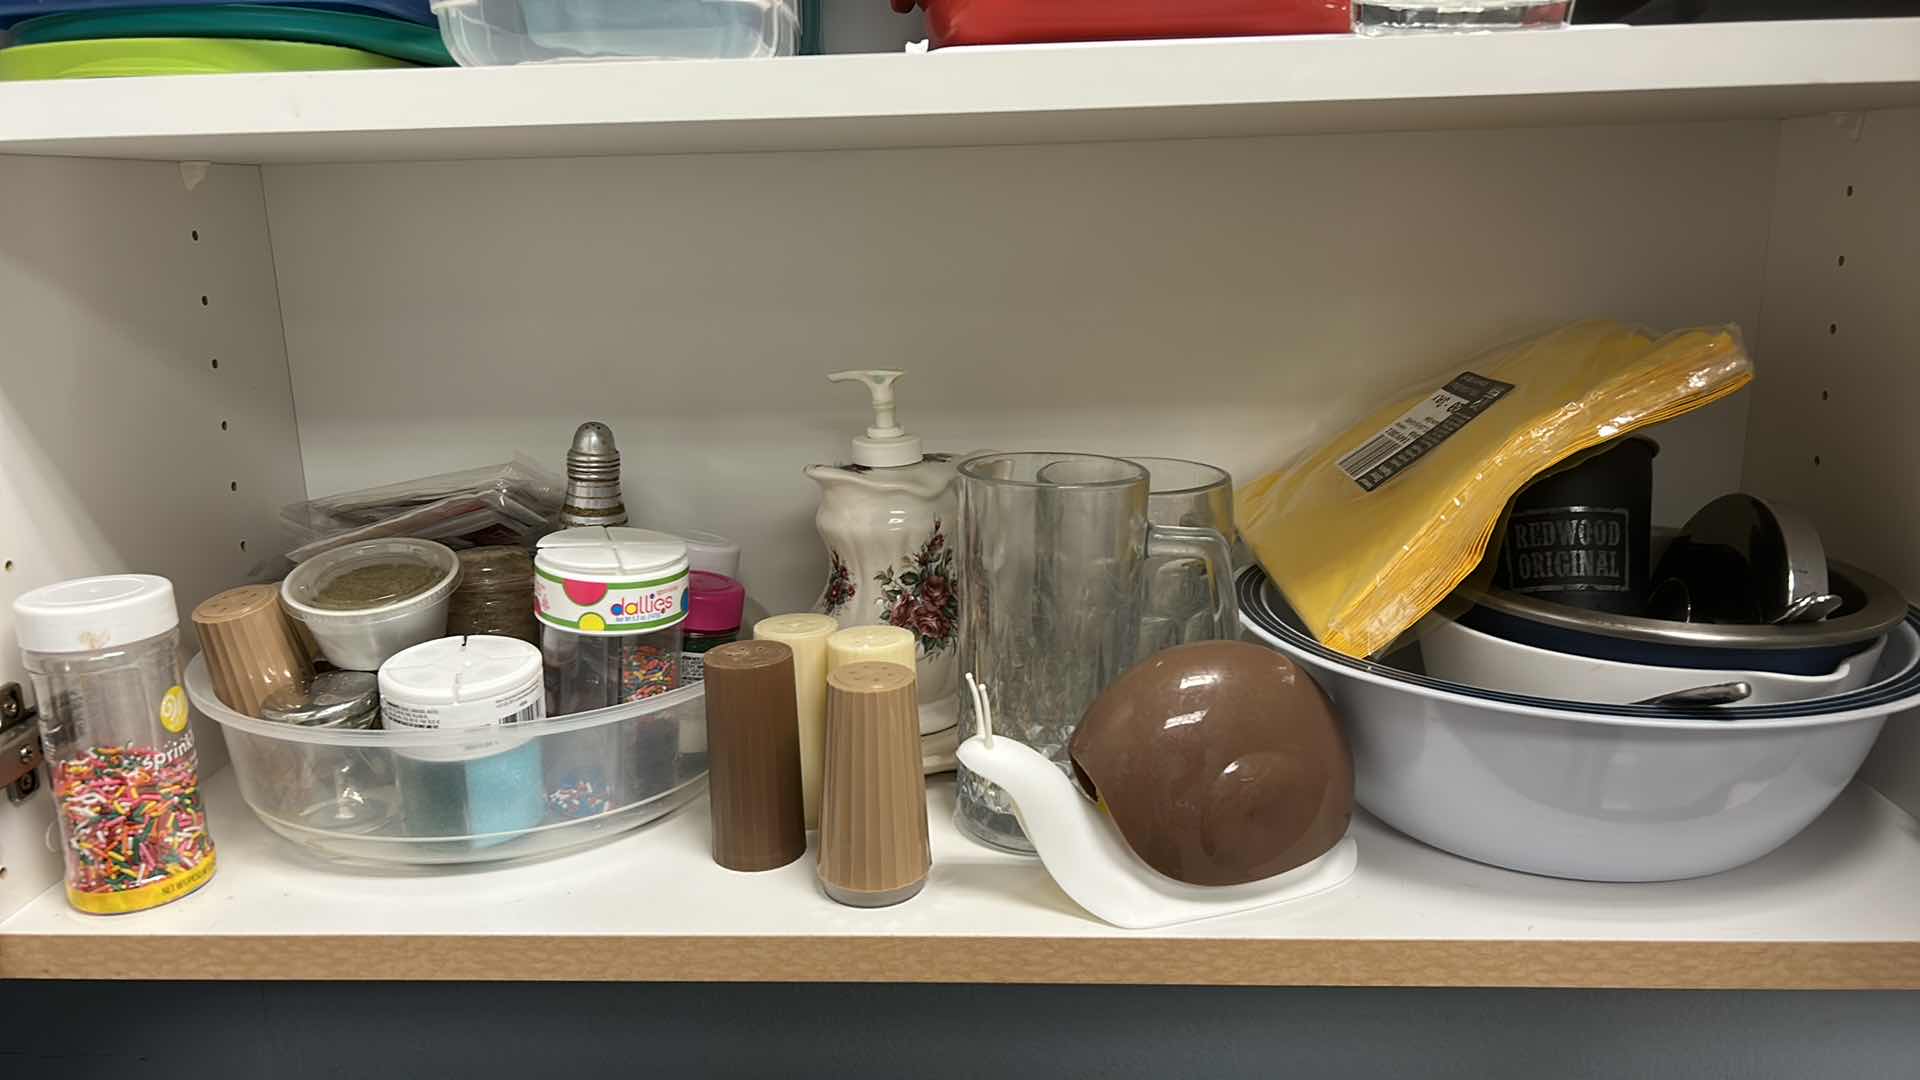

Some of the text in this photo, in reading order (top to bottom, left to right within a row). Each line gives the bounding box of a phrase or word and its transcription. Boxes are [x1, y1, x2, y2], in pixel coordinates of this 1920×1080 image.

[1516, 519, 1620, 547] REDWOOD
[1519, 550, 1620, 578] ORIGINAL
[610, 594, 673, 616] dallies
